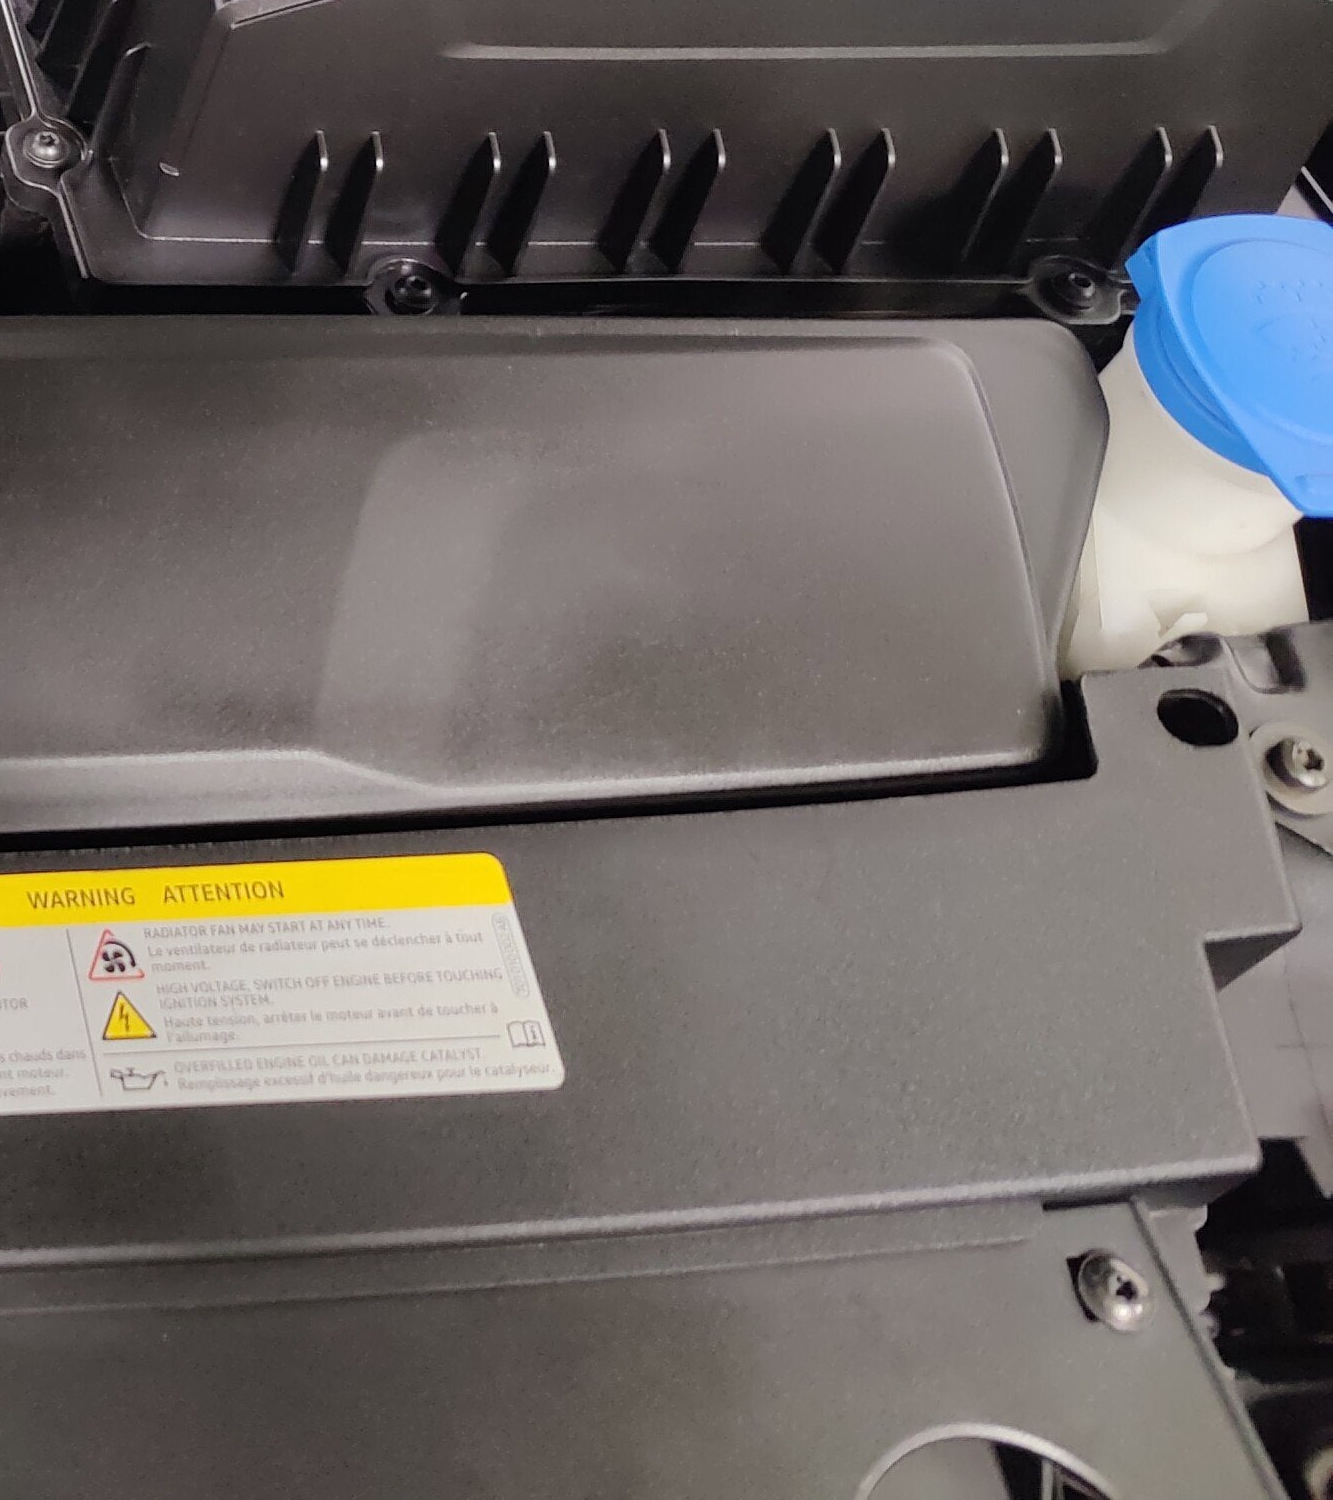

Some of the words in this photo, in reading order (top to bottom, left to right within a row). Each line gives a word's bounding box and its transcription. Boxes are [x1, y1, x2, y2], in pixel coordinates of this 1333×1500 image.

[26, 886, 136, 910] WARNING
[163, 880, 285, 905] ATTENTION
[143, 924, 207, 939] RADIATOR
[210, 924, 236, 937] FAN
[238, 922, 264, 935] MAY
[267, 920, 306, 934] START
[309, 919, 324, 932] AT
[328, 918, 352, 931] ANY
[147, 945, 163, 957] Le
[167, 942, 236, 957] ventilateur
[239, 941, 255, 953] de
[258, 939, 317, 952] radiateur
[321, 937, 350, 953] peut
[353, 939, 369, 949] se
[455, 931, 484, 943] tout
[155, 982, 189, 995] HIGH
[253, 976, 303, 991] SWITCH
[305, 975, 330, 989] OFF
[332, 973, 382, 987] ENGINE
[383, 970, 434, 985] BEFORE
[436, 967, 503, 982] TOUCHING
[159, 996, 218, 1010] IGNITION
[163, 1015, 204, 1029] Haute
[326, 1009, 373, 1021] moteur
[377, 1007, 415, 1020] avant
[417, 1004, 434, 1017] de
[436, 1002, 486, 1016] toucher
[8, 1048, 53, 1062] chauds
[56, 1048, 87, 1061] dans
[256, 1055, 305, 1070] ENGINE
[332, 1052, 360, 1066] CAN
[361, 1050, 417, 1066] DAMAGE
[436, 1069, 467, 1084] pour
